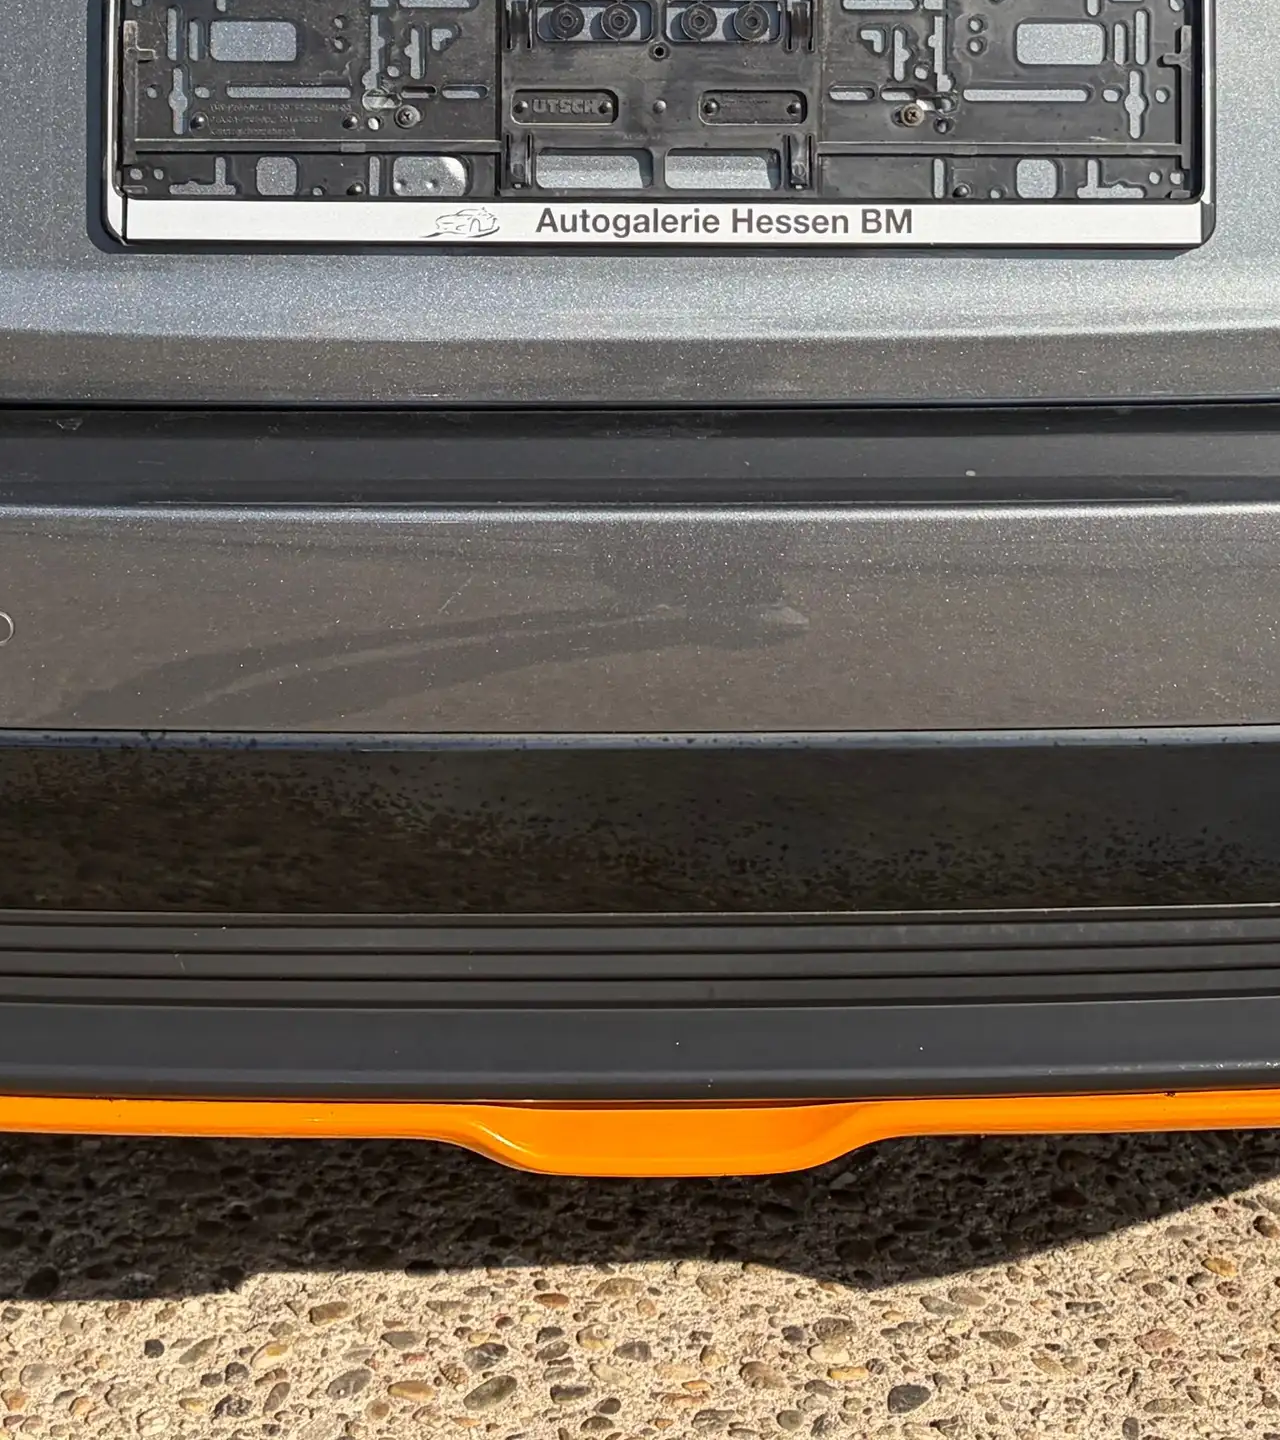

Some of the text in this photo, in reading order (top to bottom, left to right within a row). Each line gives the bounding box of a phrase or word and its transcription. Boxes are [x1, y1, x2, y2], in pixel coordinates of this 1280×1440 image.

[532, 98, 599, 114] UTSCH
[535, 207, 913, 239] Autogalerie Hessen BM
